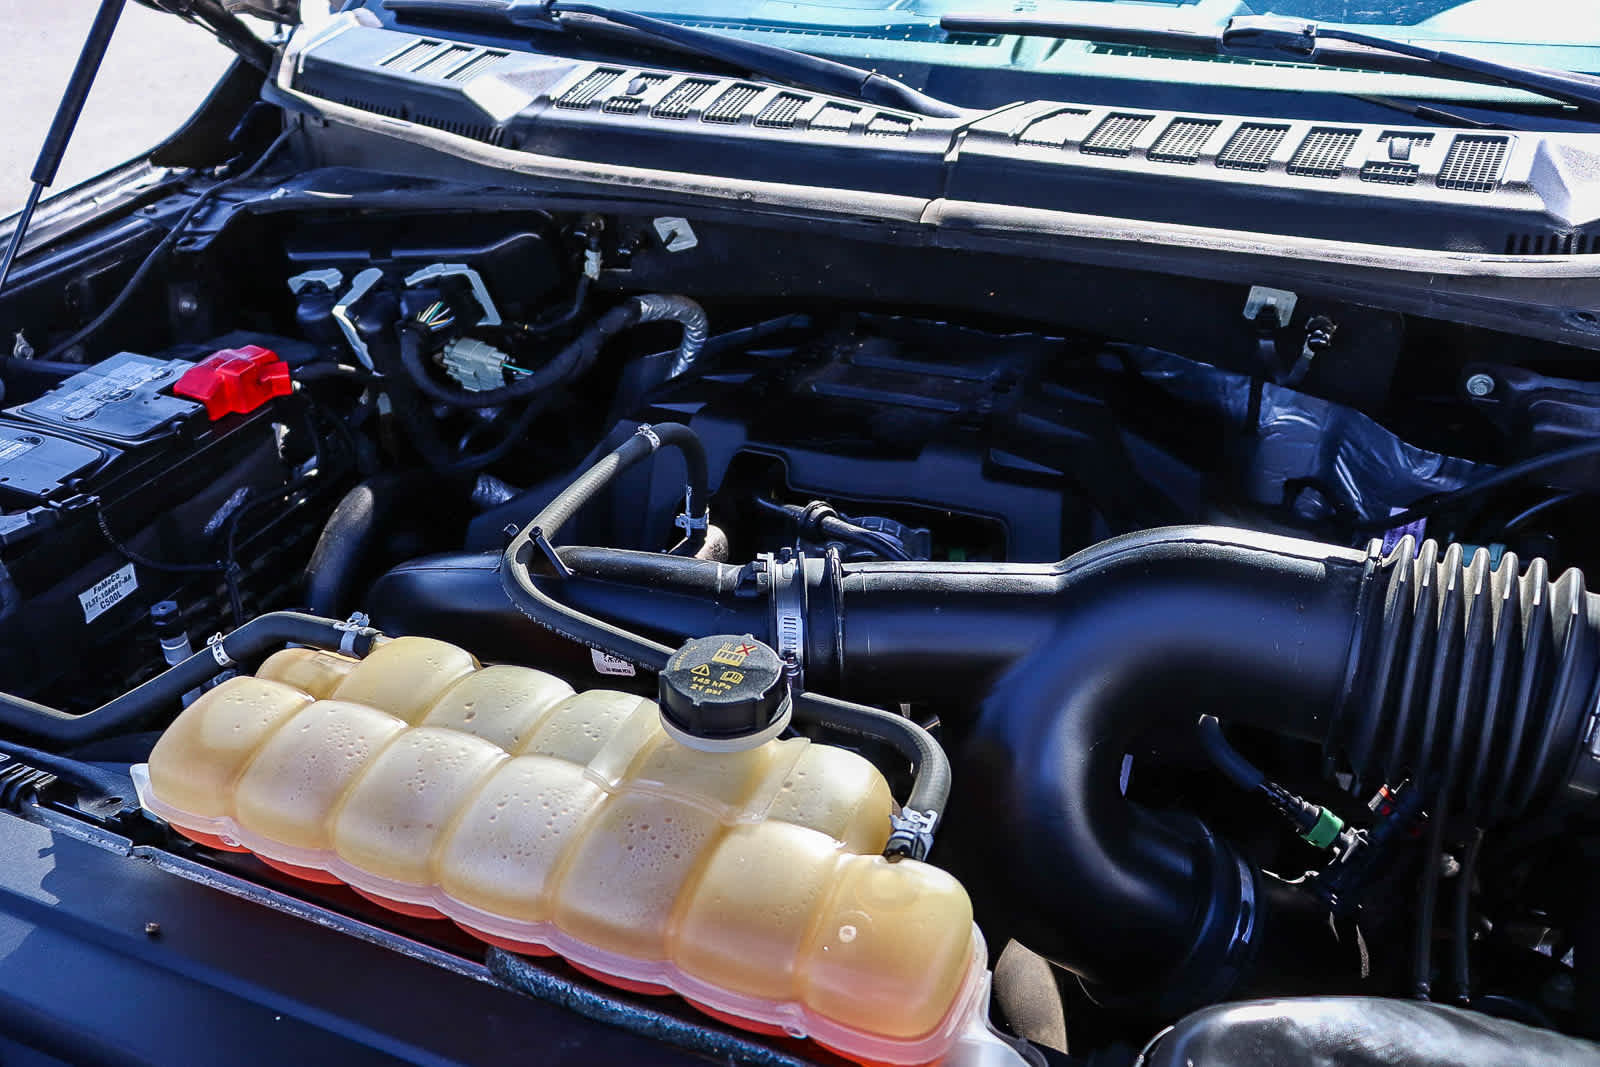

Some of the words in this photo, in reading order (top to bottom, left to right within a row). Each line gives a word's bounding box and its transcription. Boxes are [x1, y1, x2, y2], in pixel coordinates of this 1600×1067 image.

[93, 573, 120, 594] FoMoCo
[689, 683, 705, 691] 21
[704, 688, 723, 696] psi
[692, 676, 711, 685] 145
[712, 681, 732, 690] kPa
